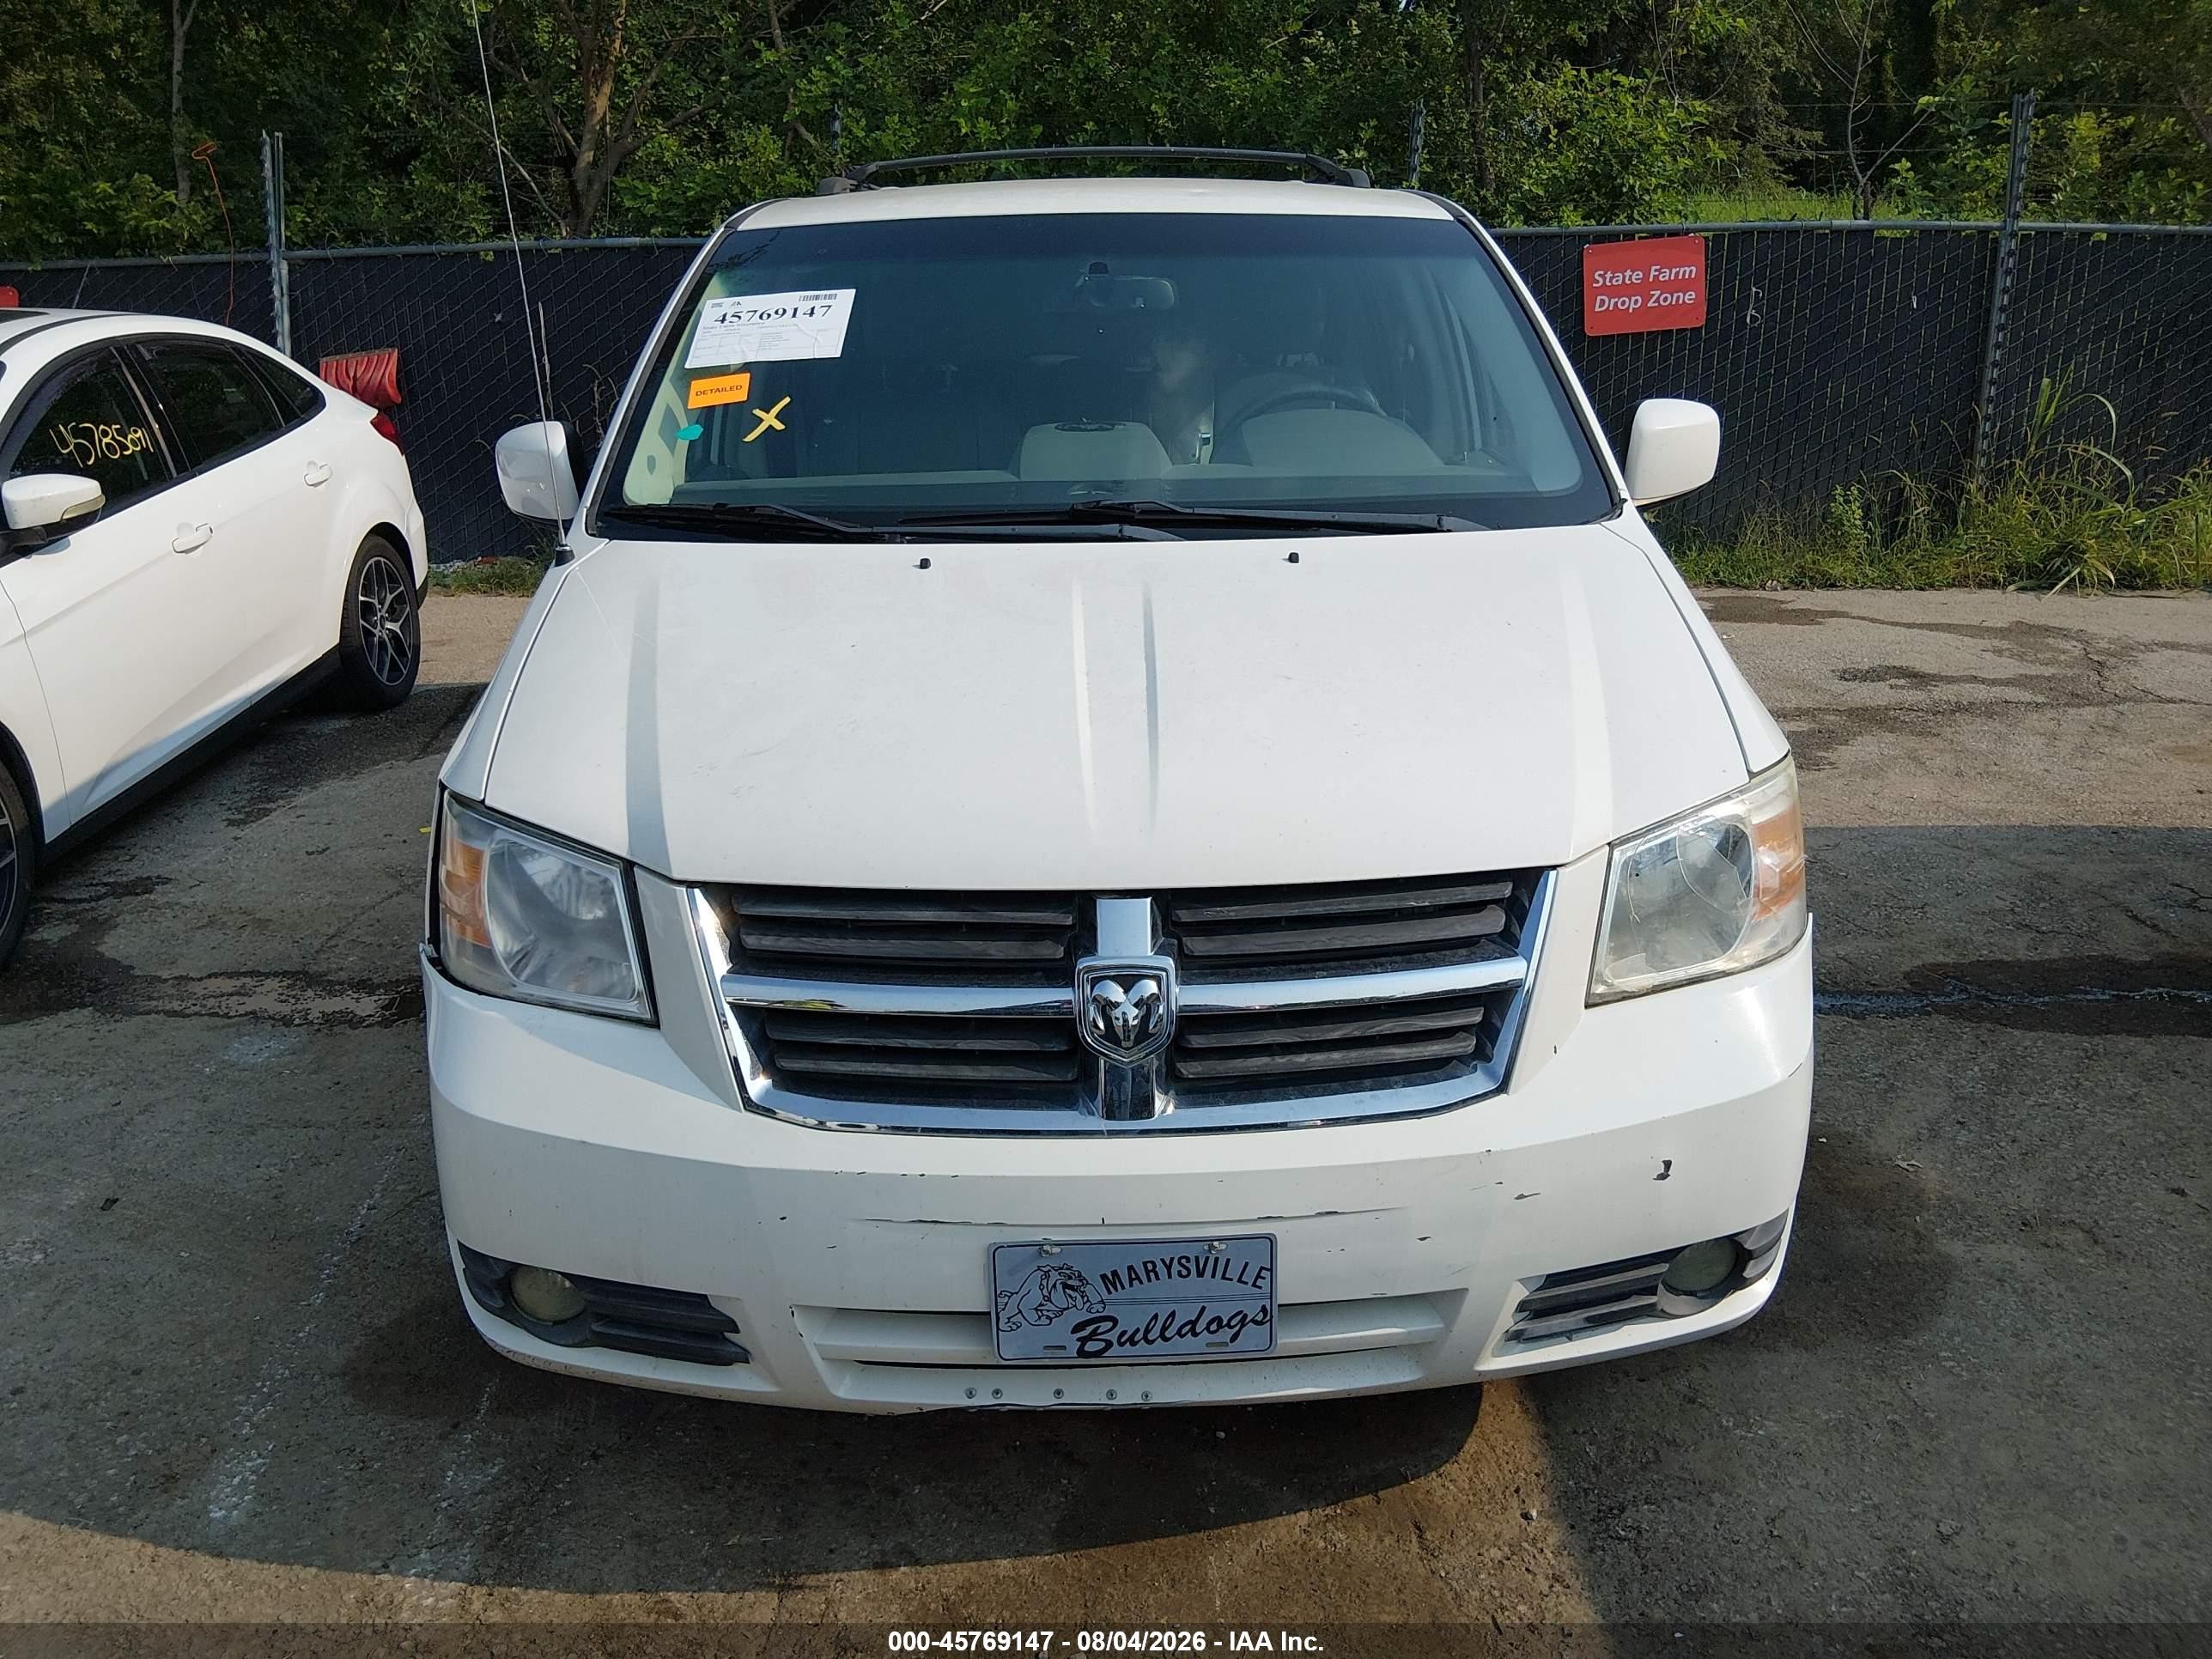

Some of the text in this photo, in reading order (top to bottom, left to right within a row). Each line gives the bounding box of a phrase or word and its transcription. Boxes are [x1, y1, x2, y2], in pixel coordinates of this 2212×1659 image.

[1593, 265, 1696, 287] State Farm
[1595, 290, 1696, 313] Drop Zone
[714, 305, 832, 324] 45769147
[695, 385, 743, 397] DETAILED
[1099, 1255, 1270, 1295] MARYSVILLE
[1070, 1304, 1273, 1358] Bulldogs
